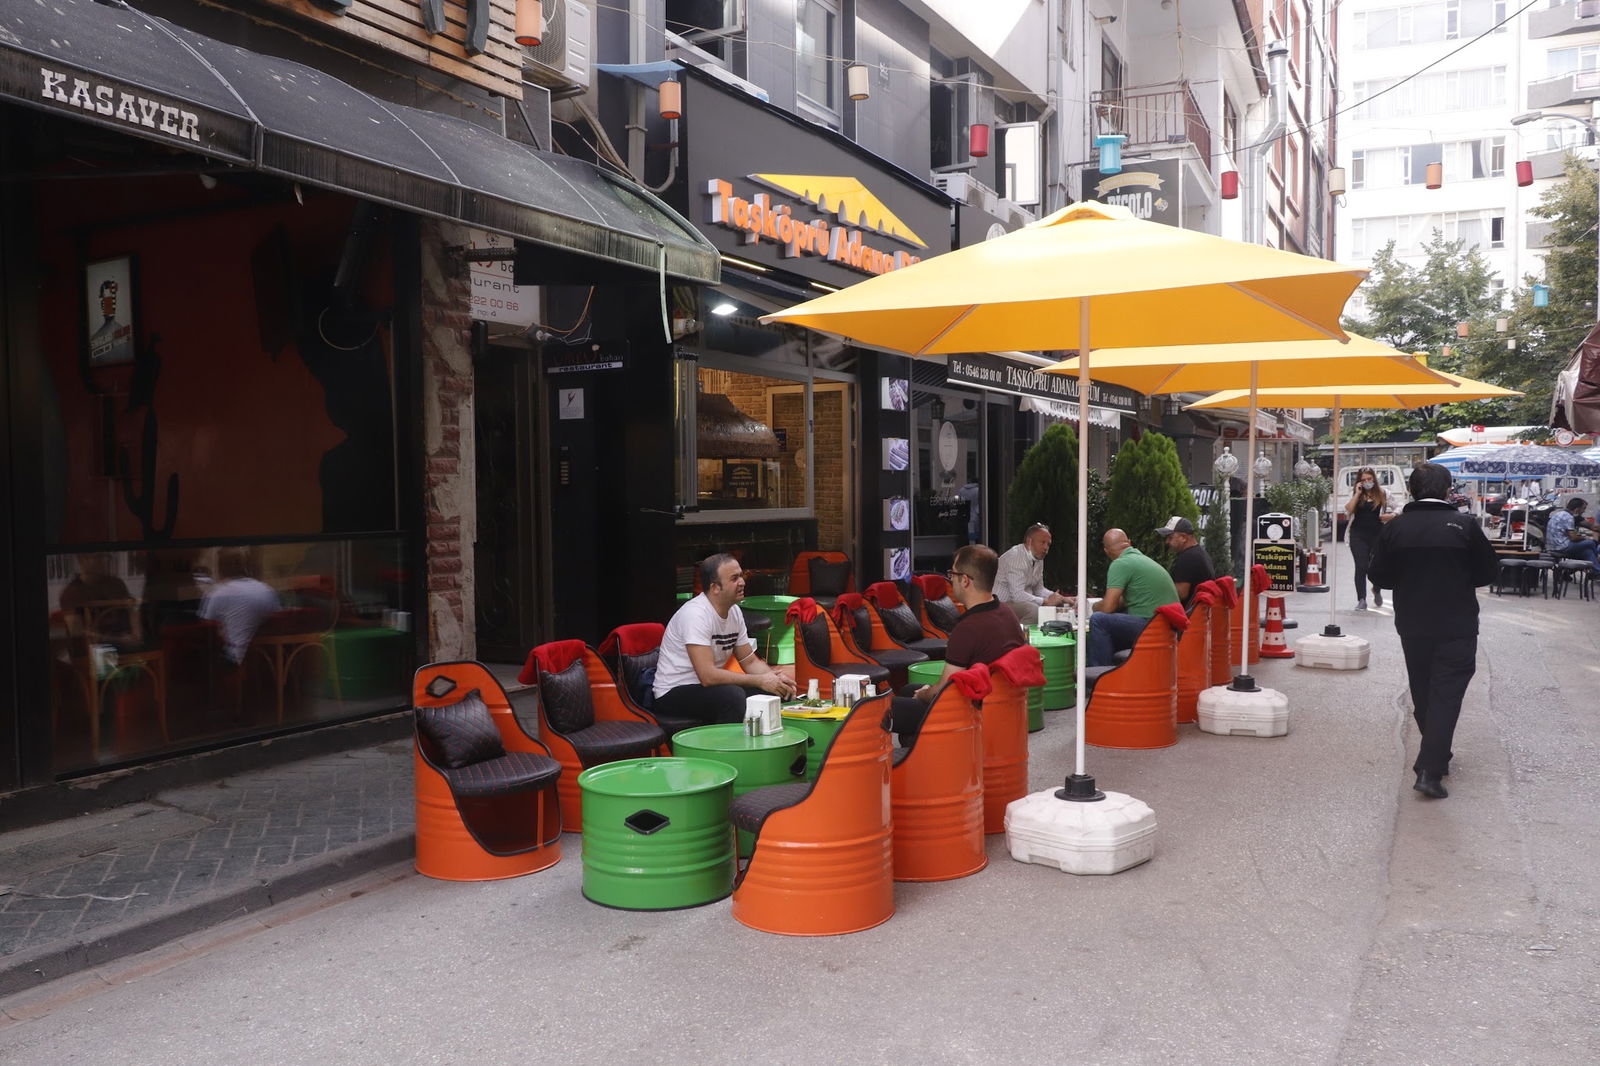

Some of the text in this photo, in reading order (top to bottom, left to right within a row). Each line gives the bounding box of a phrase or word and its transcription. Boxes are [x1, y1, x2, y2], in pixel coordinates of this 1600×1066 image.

[40, 67, 201, 142] KASAVER
[708, 178, 830, 259] Taşköprü
[827, 226, 895, 276] Adana
[559, 363, 614, 372] restaurant
[965, 364, 980, 378] 0546
[980, 367, 989, 380] 138
[1256, 553, 1293, 561] Taşköprü
